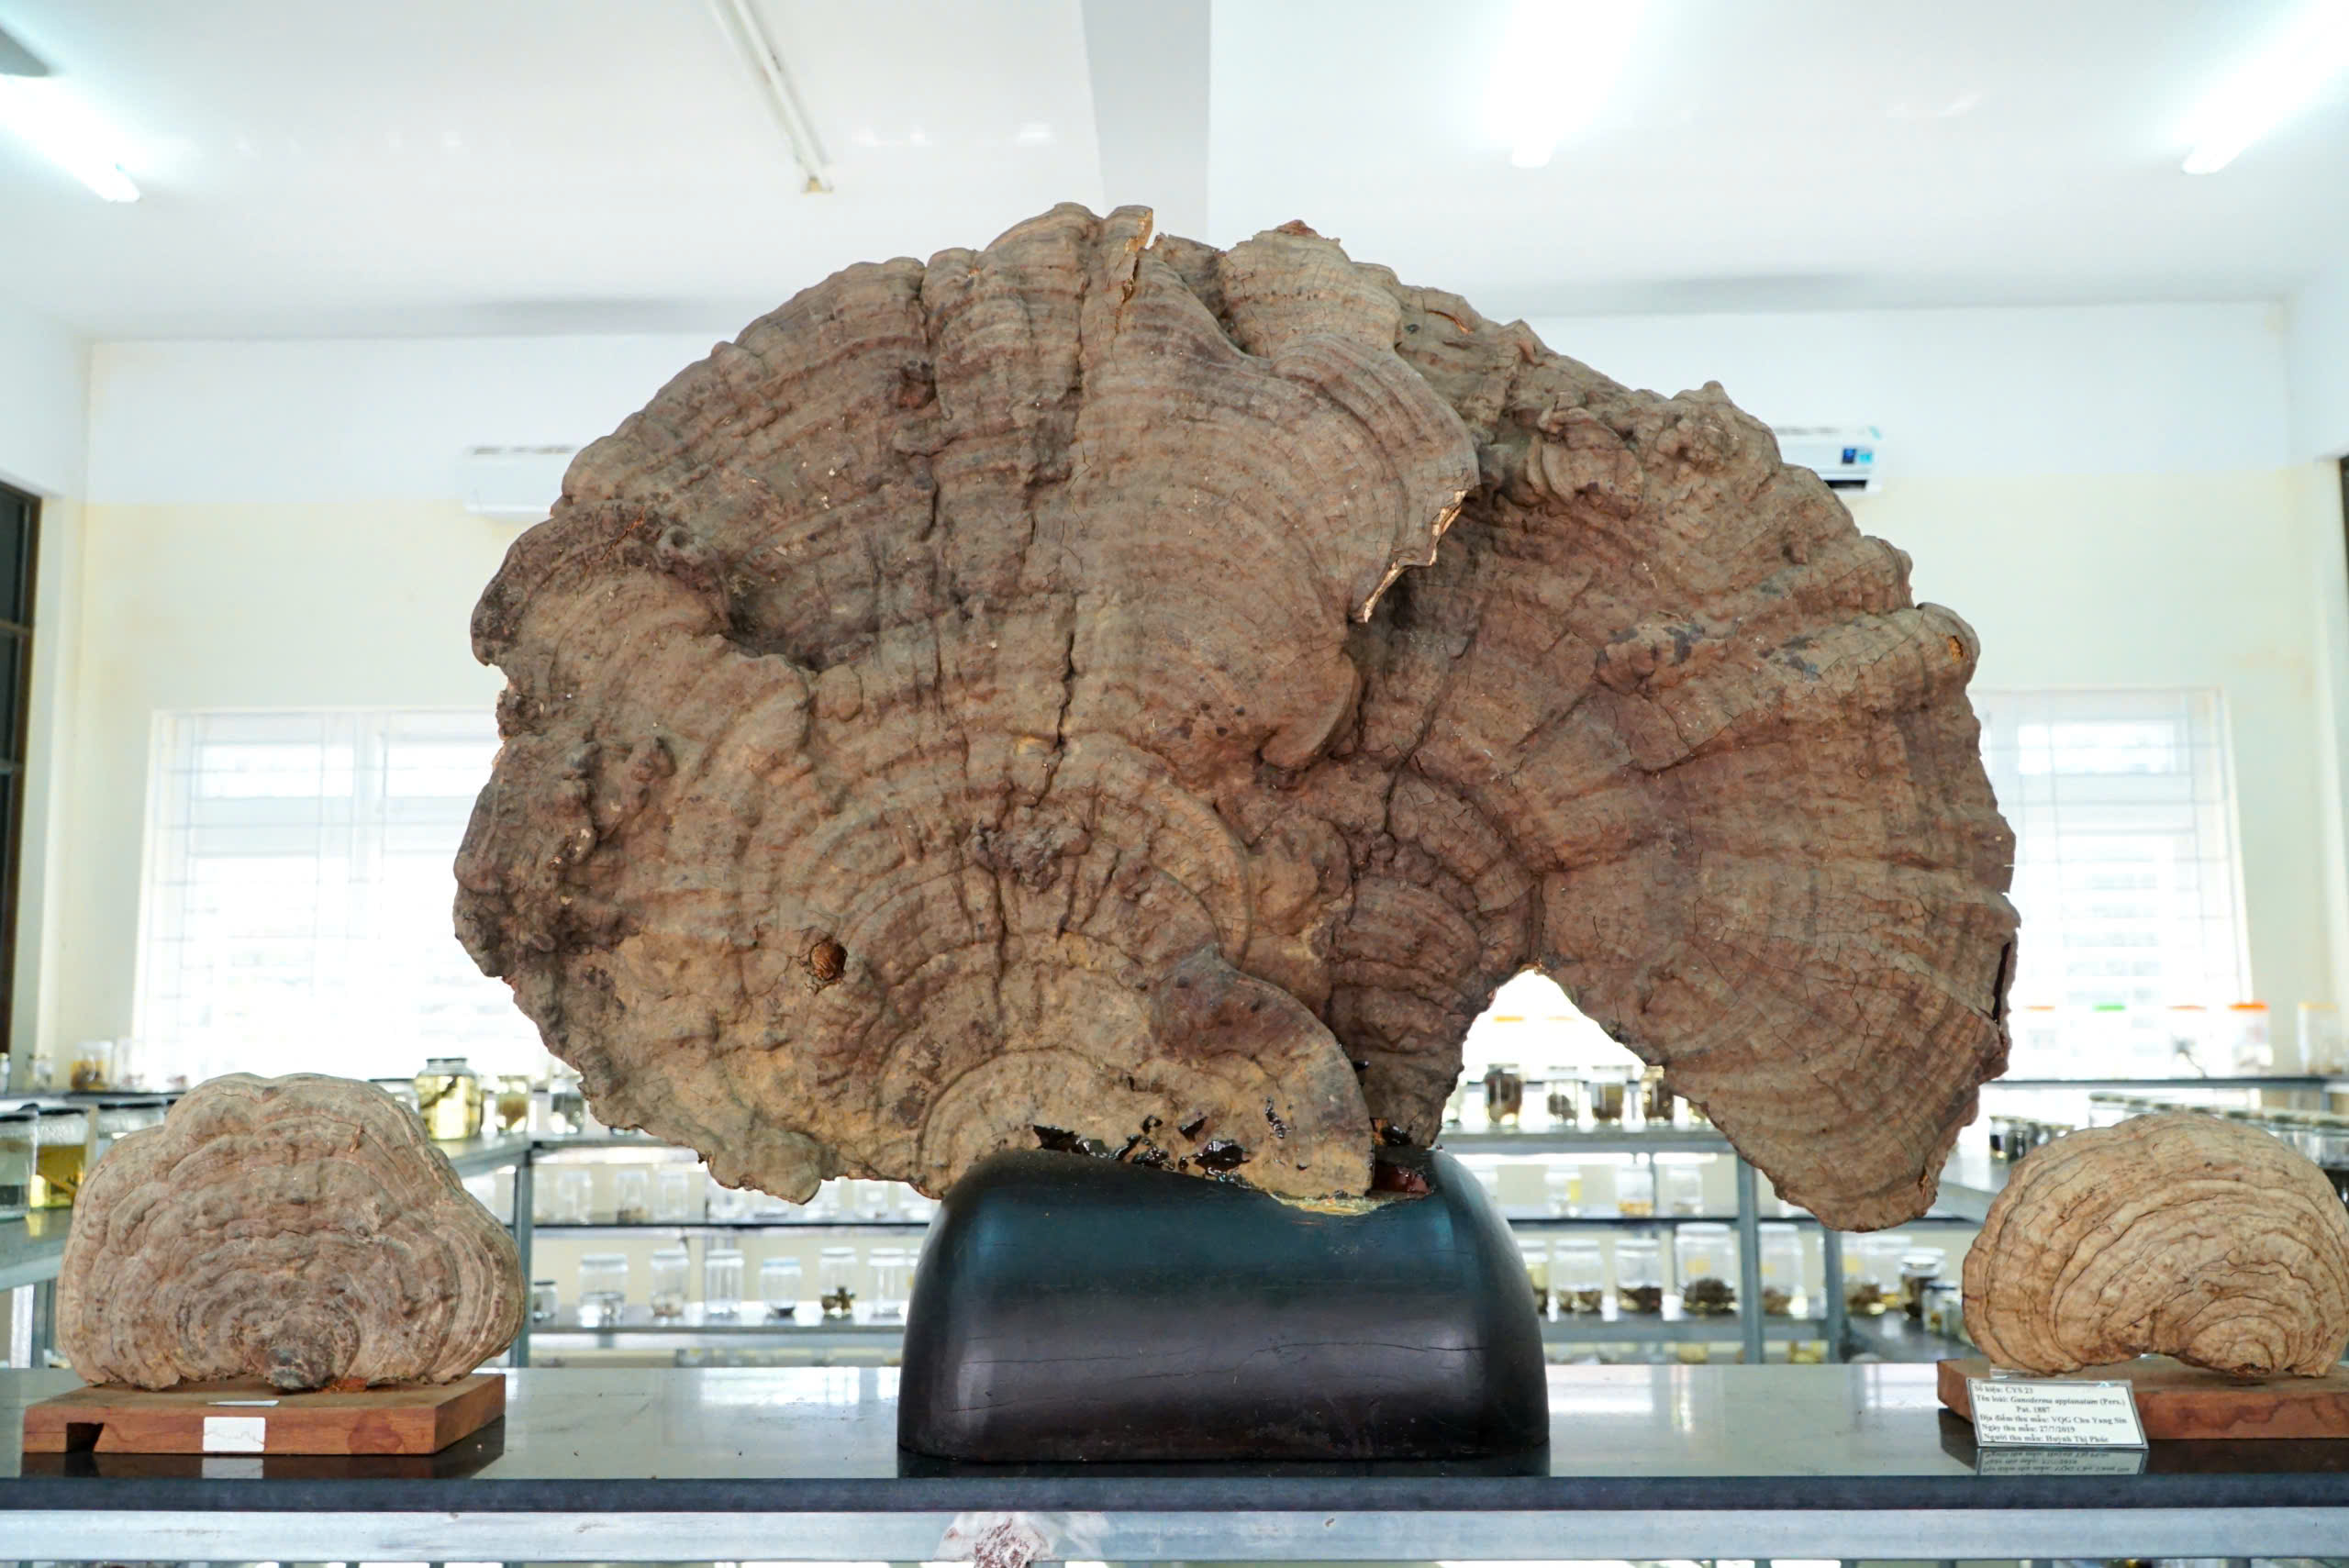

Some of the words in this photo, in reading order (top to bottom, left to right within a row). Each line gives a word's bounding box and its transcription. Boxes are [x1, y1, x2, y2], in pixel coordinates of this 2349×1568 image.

[2054, 1397, 2098, 1406] applanatum
[2051, 1416, 2071, 1424] VQG
[2074, 1436, 2087, 1444] Thị
